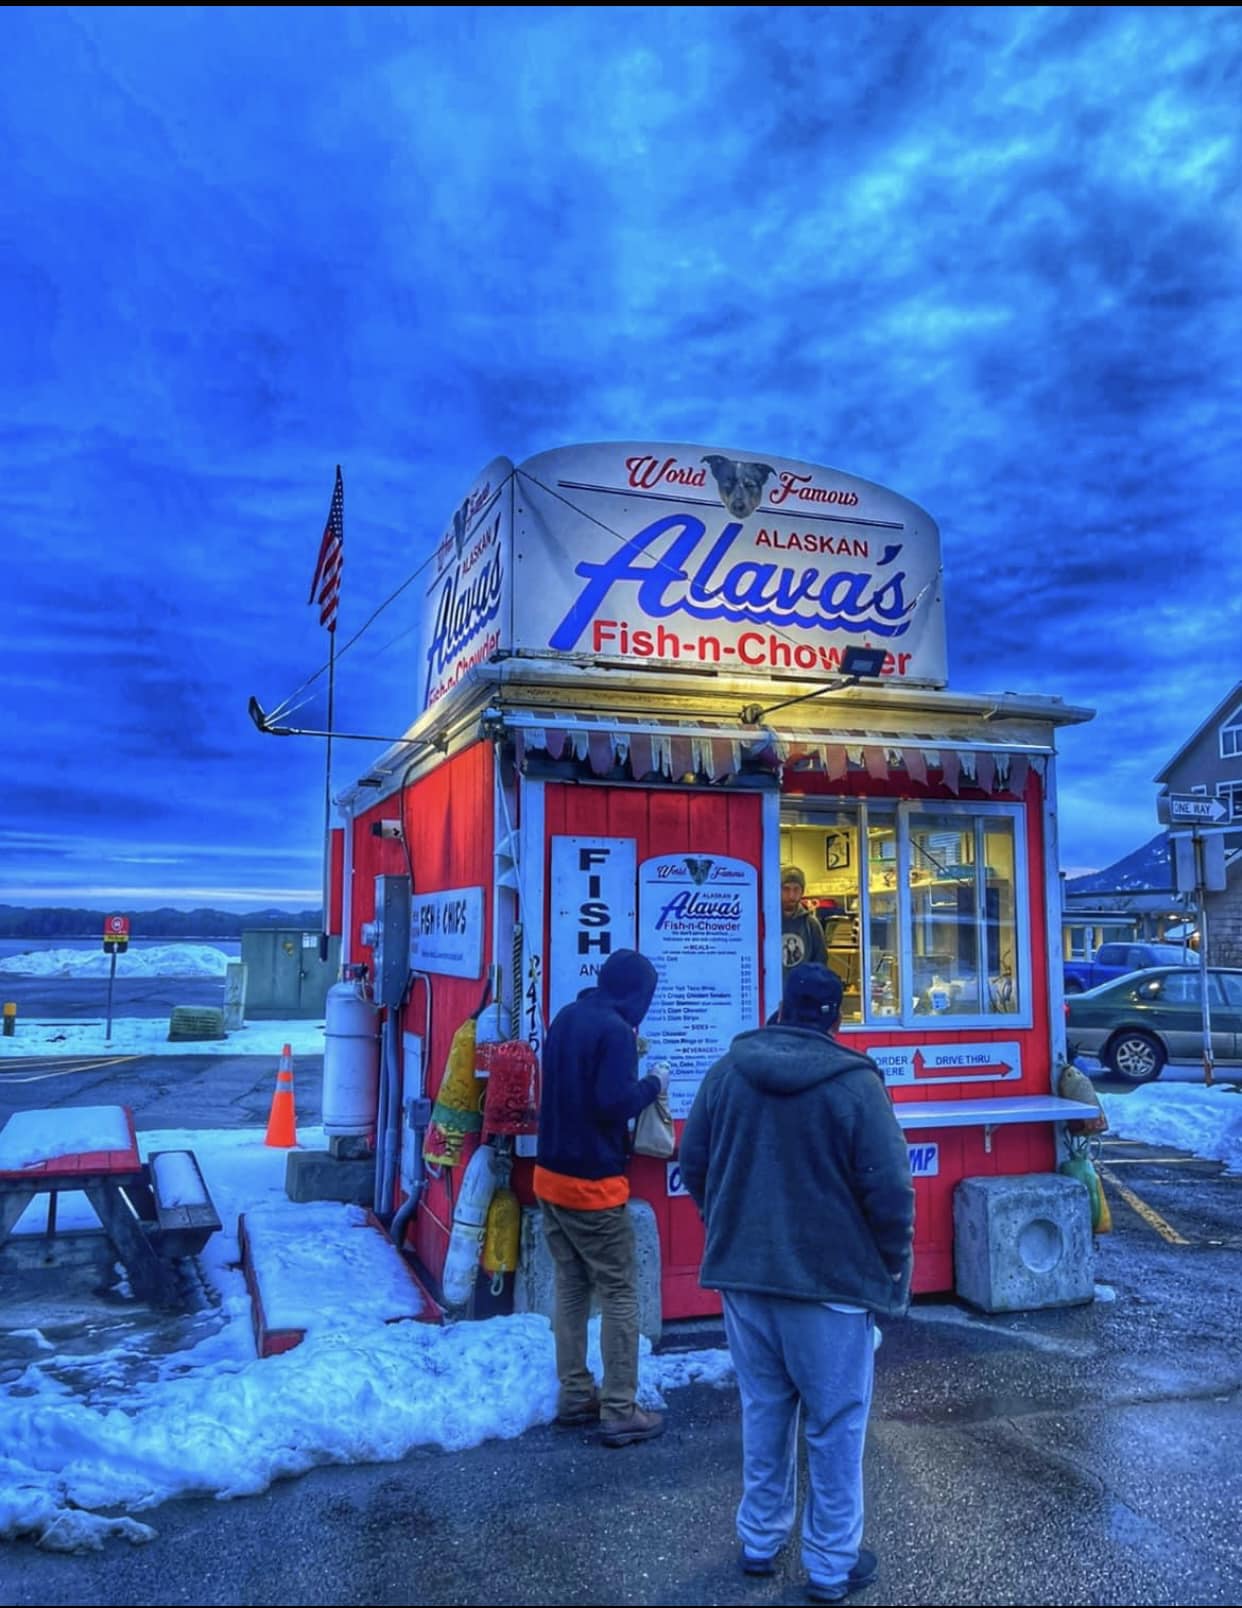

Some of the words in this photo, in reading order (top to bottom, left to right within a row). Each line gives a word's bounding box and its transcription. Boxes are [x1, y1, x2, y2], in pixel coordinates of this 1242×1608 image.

[625, 456, 705, 490] World
[769, 471, 859, 507] Famous
[462, 526, 492, 574] ALASKAN
[756, 528, 869, 557] ALASKAN
[548, 513, 912, 652] Alava's
[592, 620, 913, 676] Fish-n-Chower
[1174, 801, 1193, 814] ONE
[1194, 803, 1210, 815] WAY
[656, 864, 687, 879] World
[710, 866, 745, 879] Famous
[420, 903, 435, 936] FISH
[442, 899, 467, 935] CHIPS
[577, 848, 611, 955] FISH
[655, 890, 742, 931] Alava's
[664, 920, 741, 931] Fish-n-Chowder
[935, 1056, 966, 1065] DRIVE
[966, 1055, 991, 1064] THRU
